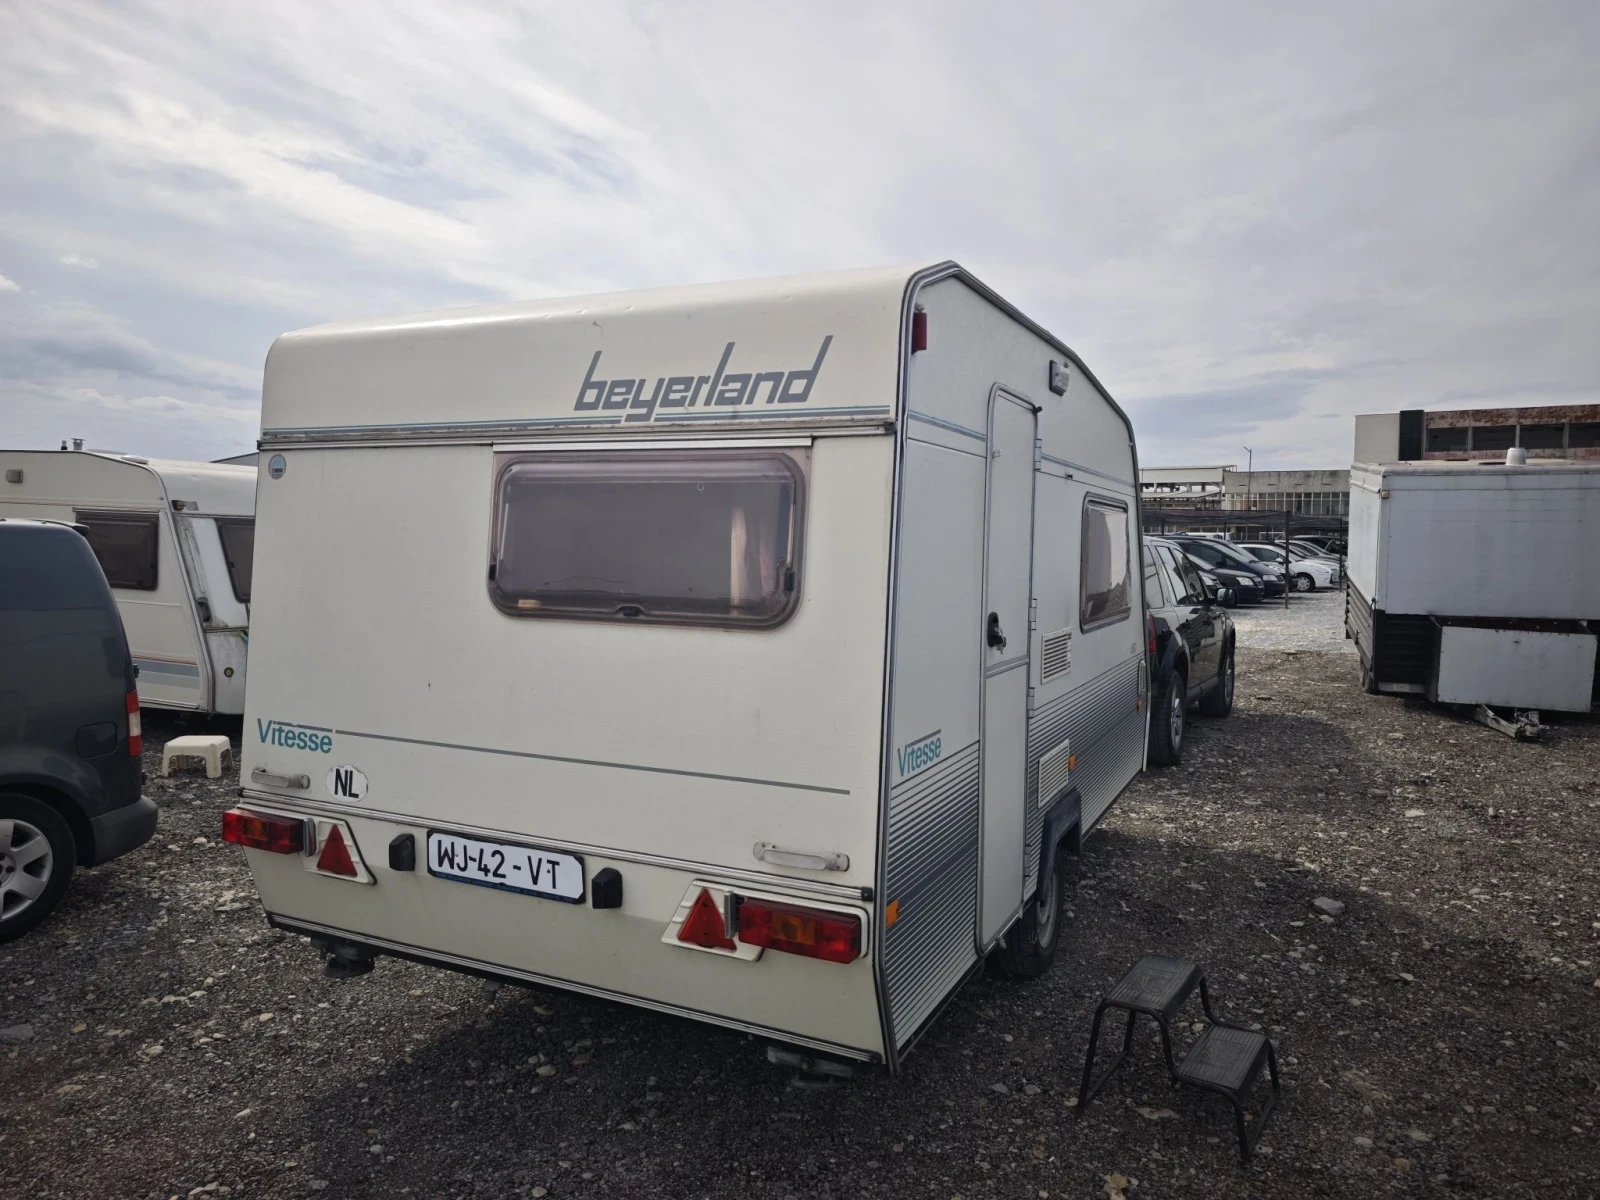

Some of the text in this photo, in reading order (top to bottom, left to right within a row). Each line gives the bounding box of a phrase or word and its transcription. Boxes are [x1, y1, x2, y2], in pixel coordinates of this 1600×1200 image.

[574, 335, 833, 422] beyerland
[257, 718, 333, 754] Vitesse
[897, 736, 942, 777] Vitesse
[334, 768, 360, 798] NL
[438, 840, 560, 889] WJ-42-VT
